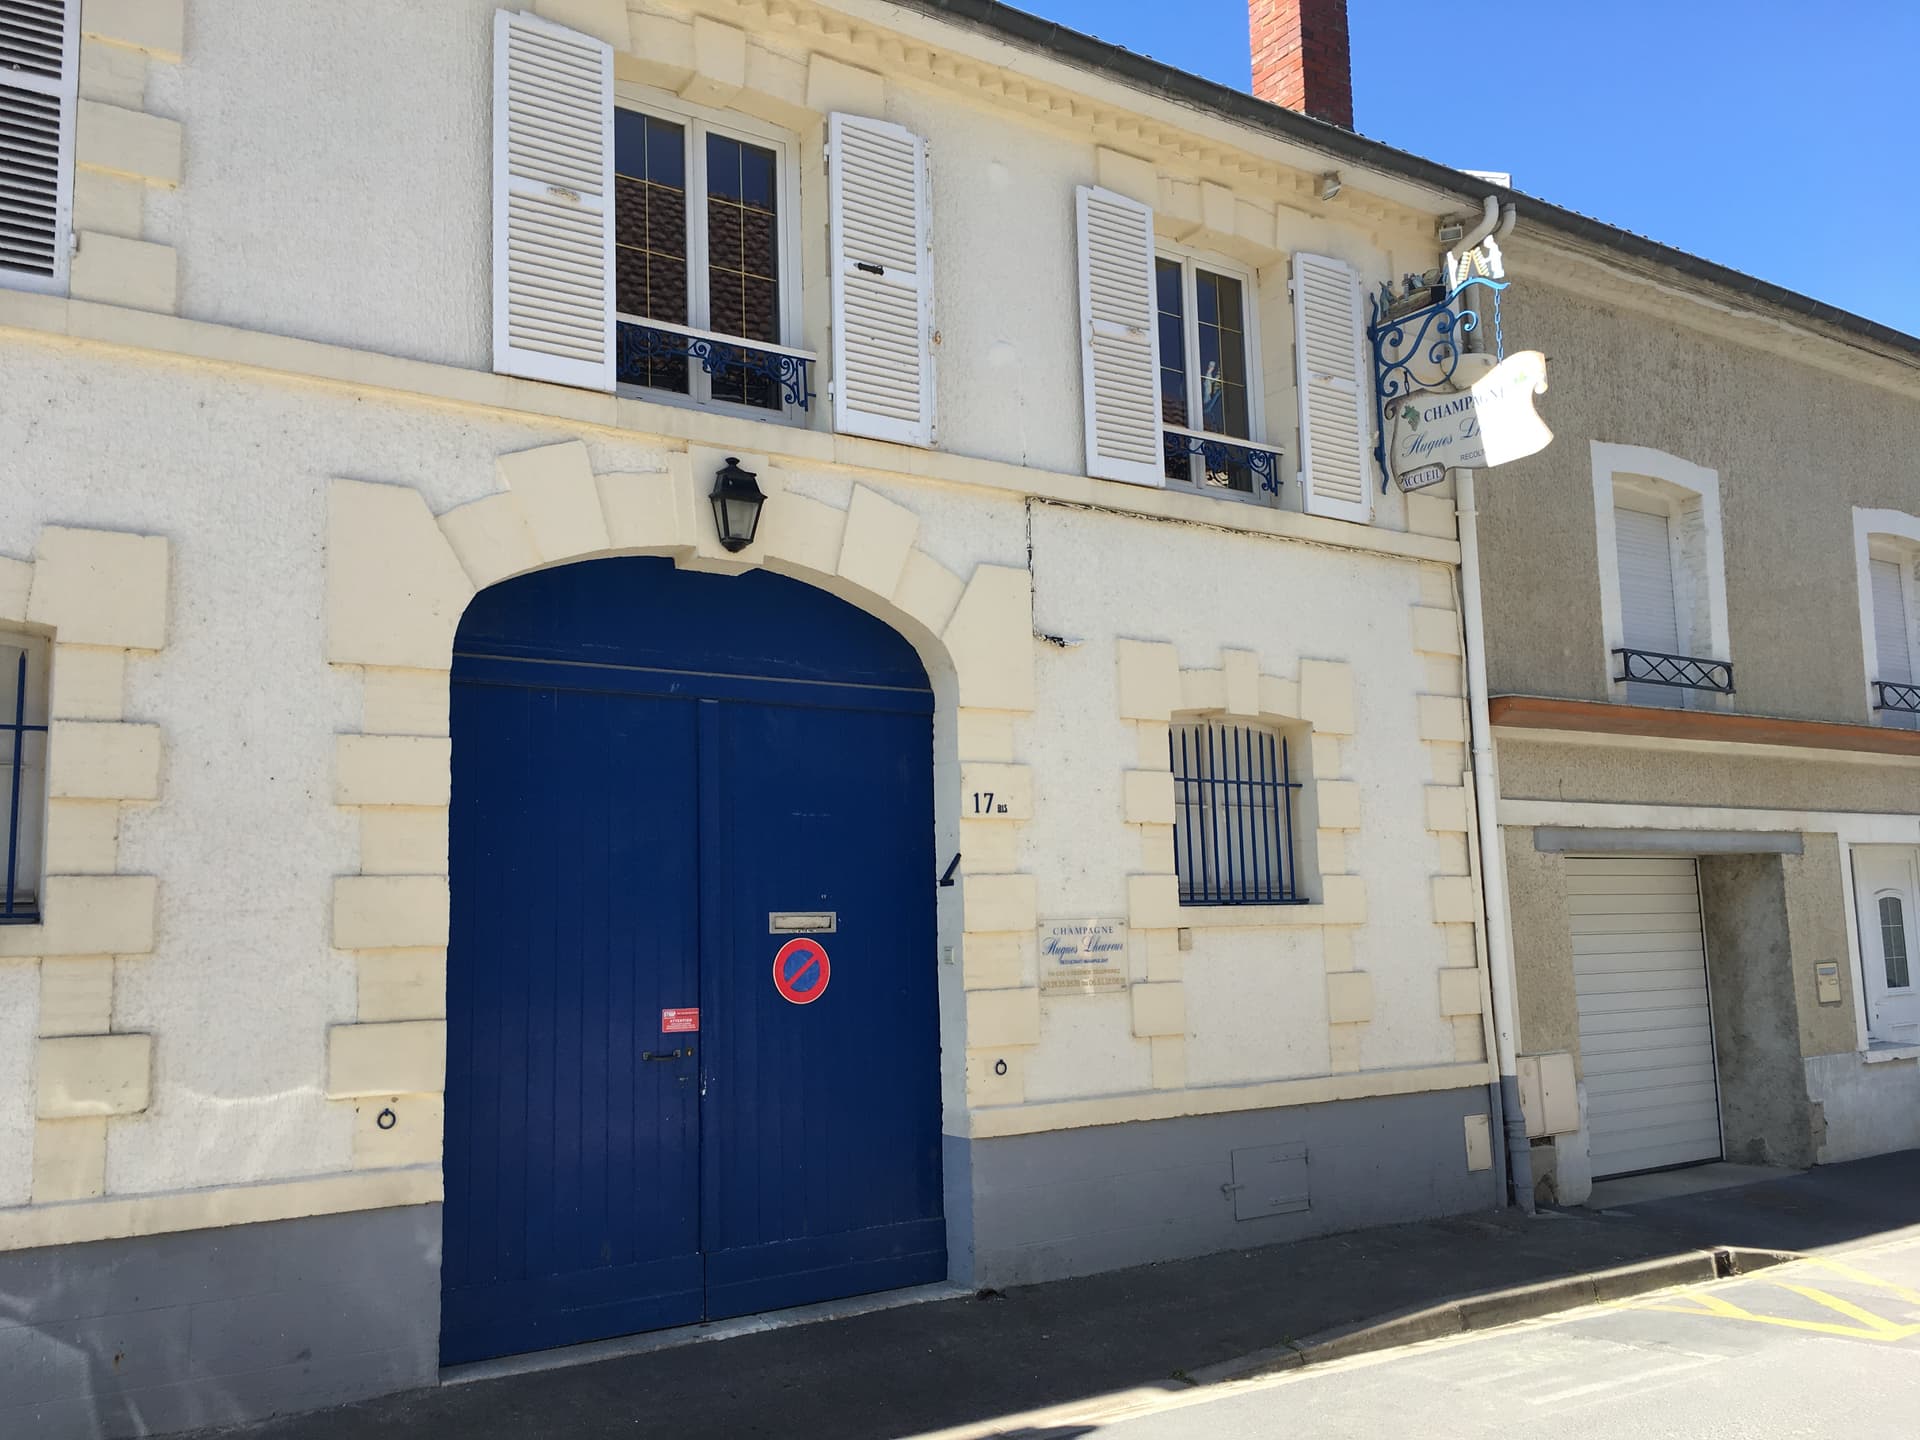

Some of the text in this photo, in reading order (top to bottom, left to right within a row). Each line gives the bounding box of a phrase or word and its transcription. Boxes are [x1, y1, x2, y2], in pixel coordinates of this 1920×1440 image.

[1401, 431, 1454, 459] Hugues
[1460, 447, 1486, 461] RECOLT
[974, 792, 994, 814] 17
[1052, 925, 1114, 936] CHAMPAGNE
[1041, 936, 1078, 960] Hugues
